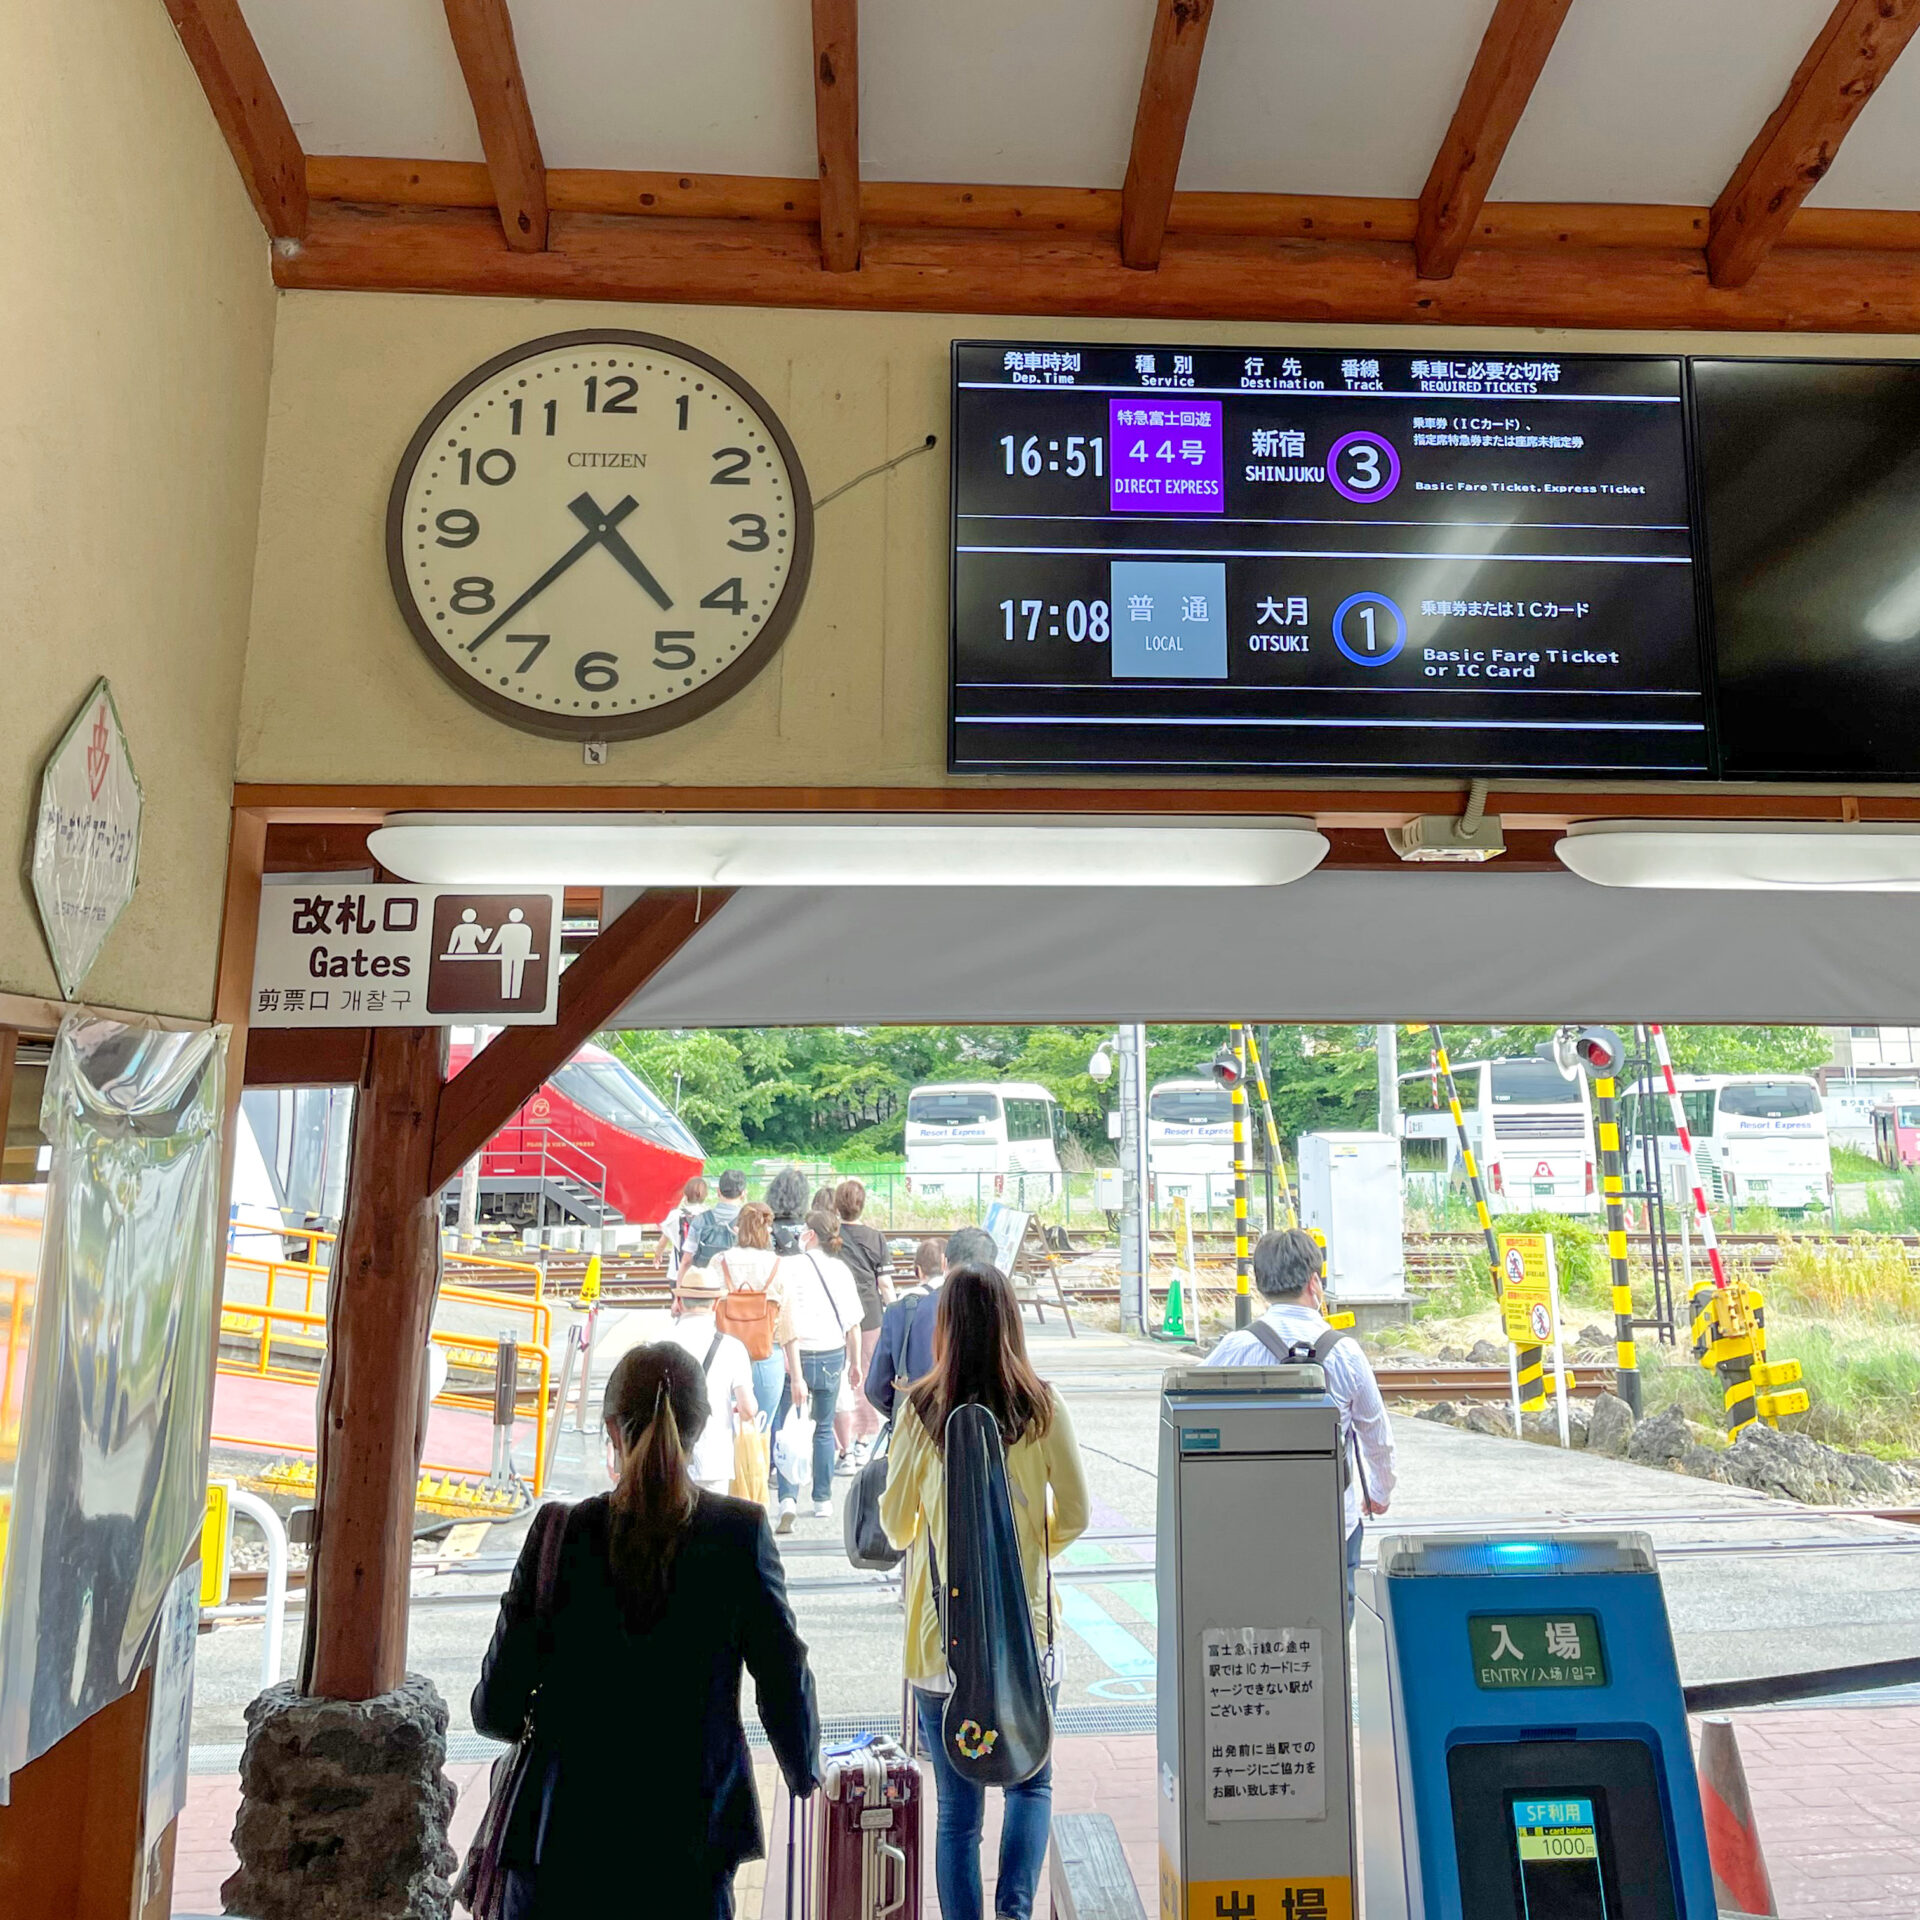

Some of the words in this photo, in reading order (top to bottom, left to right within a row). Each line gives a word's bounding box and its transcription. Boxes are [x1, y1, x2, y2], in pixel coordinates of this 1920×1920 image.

[1004, 351, 1081, 372] 発車時刻
[1341, 359, 1380, 378] 番線
[1411, 360, 1561, 382] 乗車に必要な切符
[1141, 374, 1195, 388] Service
[1240, 377, 1325, 390] Destination
[1345, 378, 1384, 391] Track
[1420, 380, 1482, 393] REQUIRED
[1484, 381, 1537, 394] TICKETS
[584, 375, 639, 414] 12
[509, 398, 557, 436] 11
[676, 395, 690, 431] 1
[1117, 410, 1212, 428] 特急富士回遊
[1251, 429, 1306, 459] 新宿
[567, 452, 647, 469] CITIZEN
[710, 447, 751, 485] 2
[1000, 435, 1104, 477] 16:51
[458, 448, 516, 486] 10
[1245, 466, 1325, 483] SHINJUKU
[1348, 445, 1381, 489] 3
[1115, 479, 1162, 494] DIRECT
[1165, 479, 1219, 495] EXPRESS
[1415, 481, 1454, 491] Basic
[1457, 482, 1488, 492] Fare
[1600, 485, 1646, 494] Ticket
[435, 508, 480, 549] 9
[727, 513, 770, 552] 3
[449, 576, 496, 615] 8
[700, 577, 748, 615] 4
[1256, 597, 1309, 626] 大月
[1420, 600, 1590, 618] 乗車券またはICカード
[999, 599, 1110, 643] 17:08
[1359, 607, 1376, 650] 1
[505, 634, 551, 674] 7
[652, 630, 696, 670] 5
[1145, 636, 1184, 652] LOCAL
[1249, 635, 1309, 652] OTSUKI
[1423, 648, 1485, 662] Basic
[1492, 649, 1541, 663] Fare
[1545, 649, 1620, 664] Ticket
[574, 651, 619, 692] 6
[1424, 666, 1449, 677] or
[1457, 665, 1480, 677] IC
[1485, 664, 1536, 678] Card
[292, 894, 419, 936] 改札口
[309, 946, 411, 978] Gates
[340, 989, 412, 1012] 개찰구
[920, 1128, 948, 1137] Resort
[952, 1128, 986, 1137] Express
[1164, 1127, 1194, 1136] Resort
[1740, 1121, 1770, 1129] Resort
[1775, 1120, 1812, 1129] Express
[1490, 1622, 1581, 1661] 入場
[1210, 1703, 1271, 1717] ございます。
[1212, 1741, 1316, 1758] 出発前に当駅での
[1212, 1762, 1316, 1778] チャージにご協力を
[1213, 1782, 1296, 1798] お願い致します。
